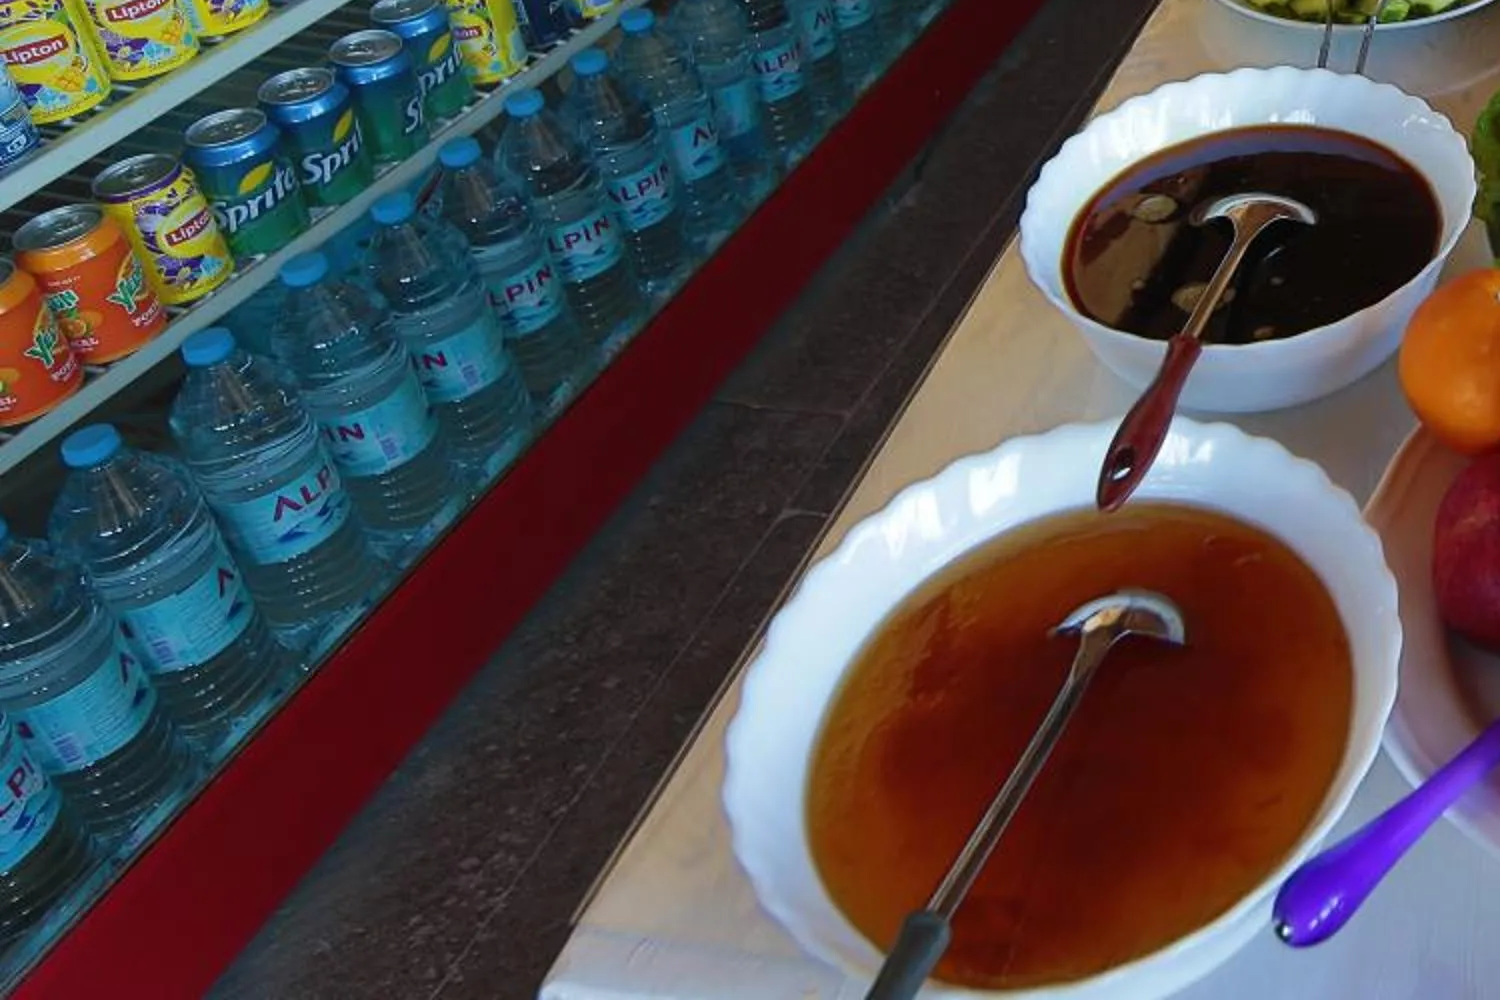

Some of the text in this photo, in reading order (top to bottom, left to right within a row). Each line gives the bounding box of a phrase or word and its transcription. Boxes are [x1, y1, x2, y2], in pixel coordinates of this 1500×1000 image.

[2, 38, 65, 64] Lipton
[547, 214, 611, 252] LPIN
[485, 263, 553, 308] LPIN
[273, 464, 333, 522] ALP
